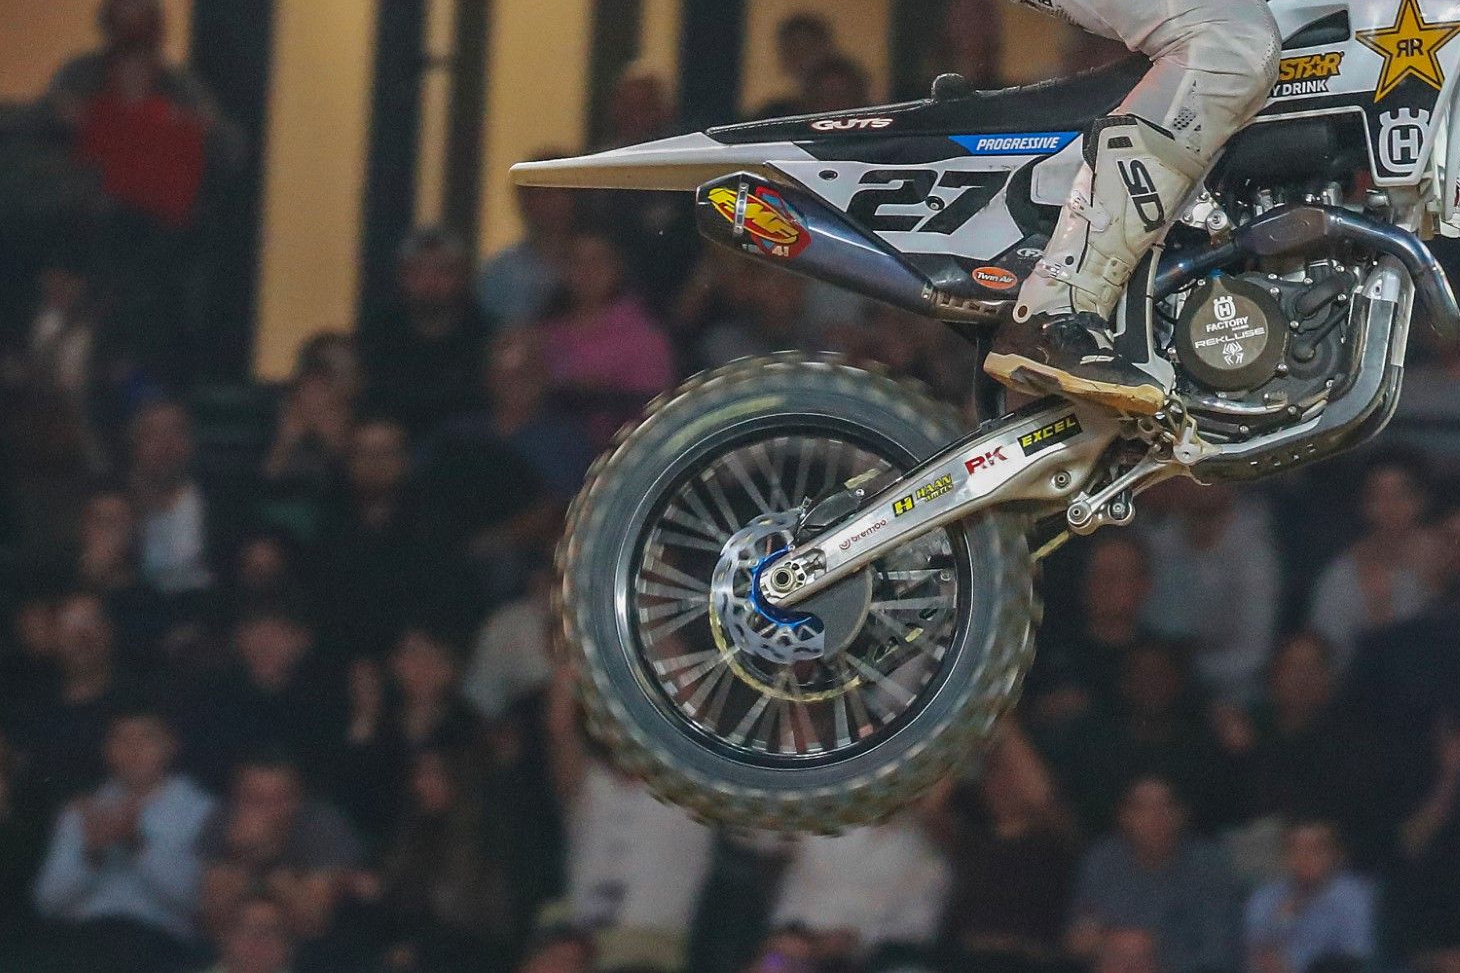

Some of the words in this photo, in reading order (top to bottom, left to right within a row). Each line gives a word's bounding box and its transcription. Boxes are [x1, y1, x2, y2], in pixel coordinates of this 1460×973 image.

[1279, 52, 1344, 82] STAR
[1281, 79, 1329, 96] DRINK
[811, 116, 894, 132] GUTS
[975, 135, 1062, 153] PROGRESSIVE
[846, 169, 1013, 236] 27
[976, 271, 999, 282] Twin
[999, 274, 1014, 284] Air
[1205, 315, 1249, 333] FACTORY
[1194, 326, 1266, 349] REKLUSE
[1021, 417, 1078, 448] EXCEL
[964, 445, 1009, 476] RK
